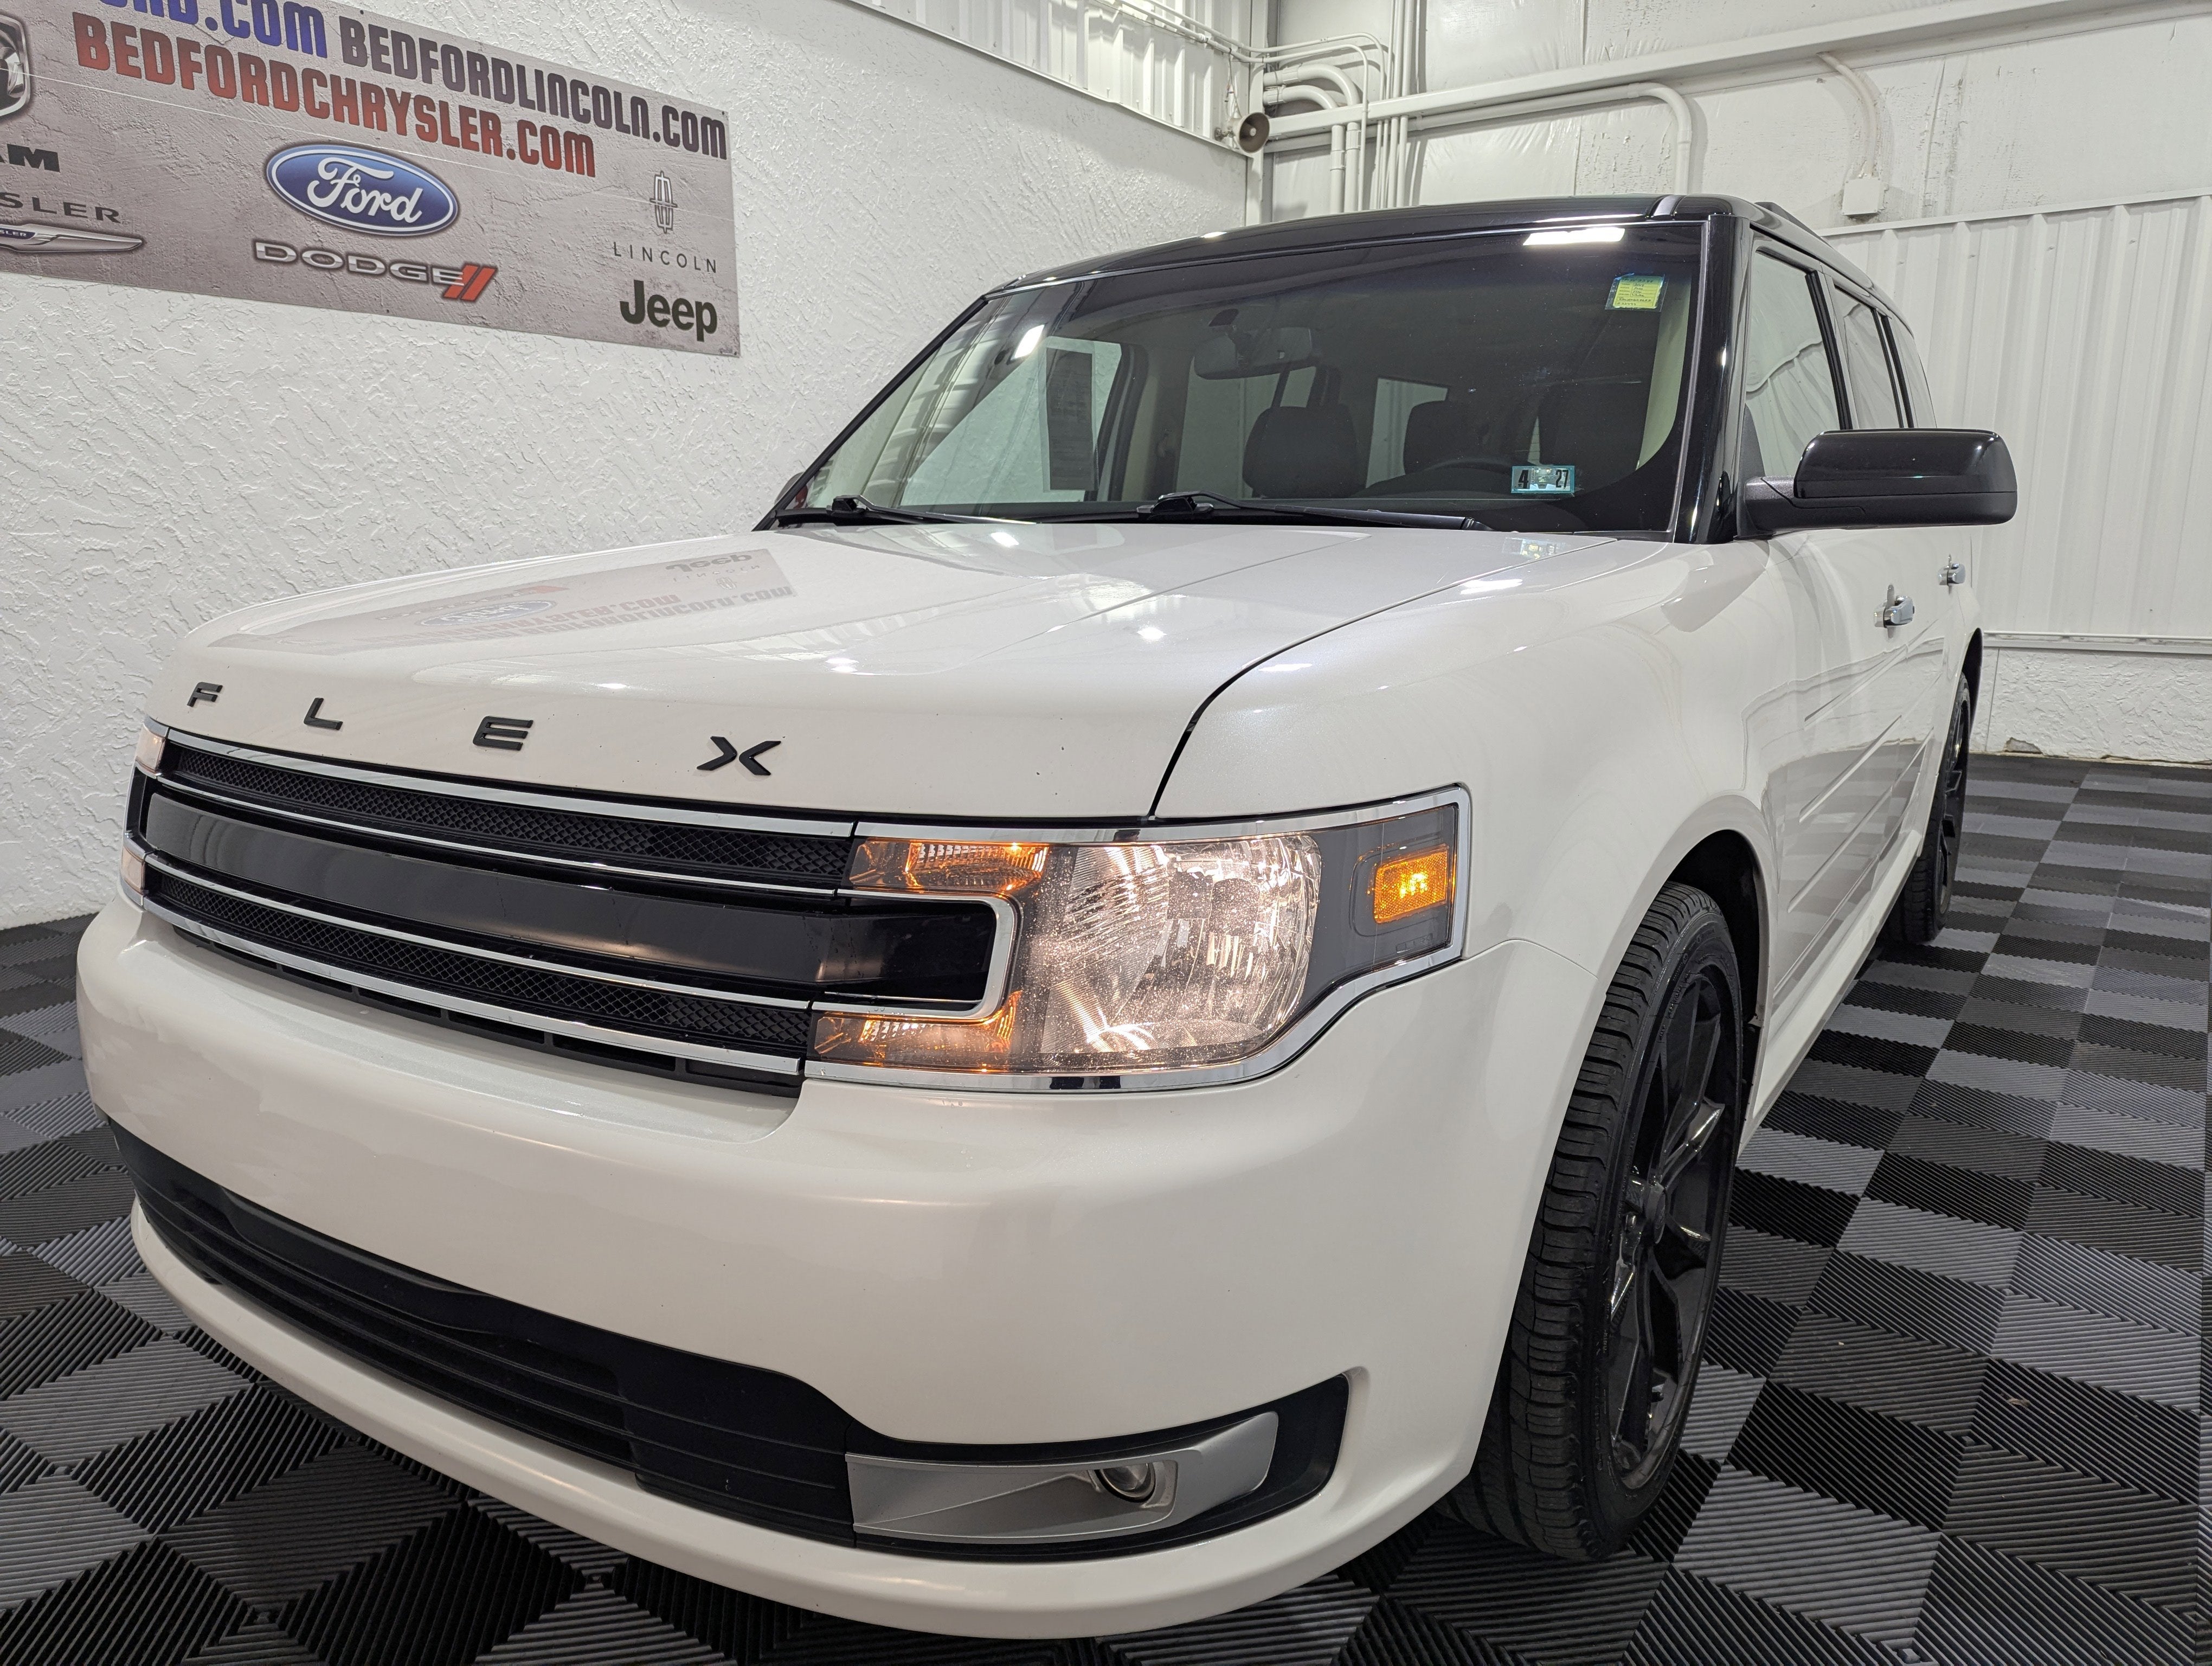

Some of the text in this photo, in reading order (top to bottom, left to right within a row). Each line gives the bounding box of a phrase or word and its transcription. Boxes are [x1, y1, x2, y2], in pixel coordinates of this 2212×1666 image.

[72, 12, 595, 178] BEDFORDCHRYSLER.COM
[339, 16, 727, 160] BEDFORDLINCOLN.COM
[0, 144, 60, 173] M
[307, 157, 423, 223] Ford
[256, 241, 465, 287] DODGE
[613, 242, 717, 274] LINCOLN
[619, 280, 718, 342] Jeep
[1518, 470, 1529, 489] 4
[1555, 469, 1569, 488] 27
[187, 681, 782, 776] FLEX
